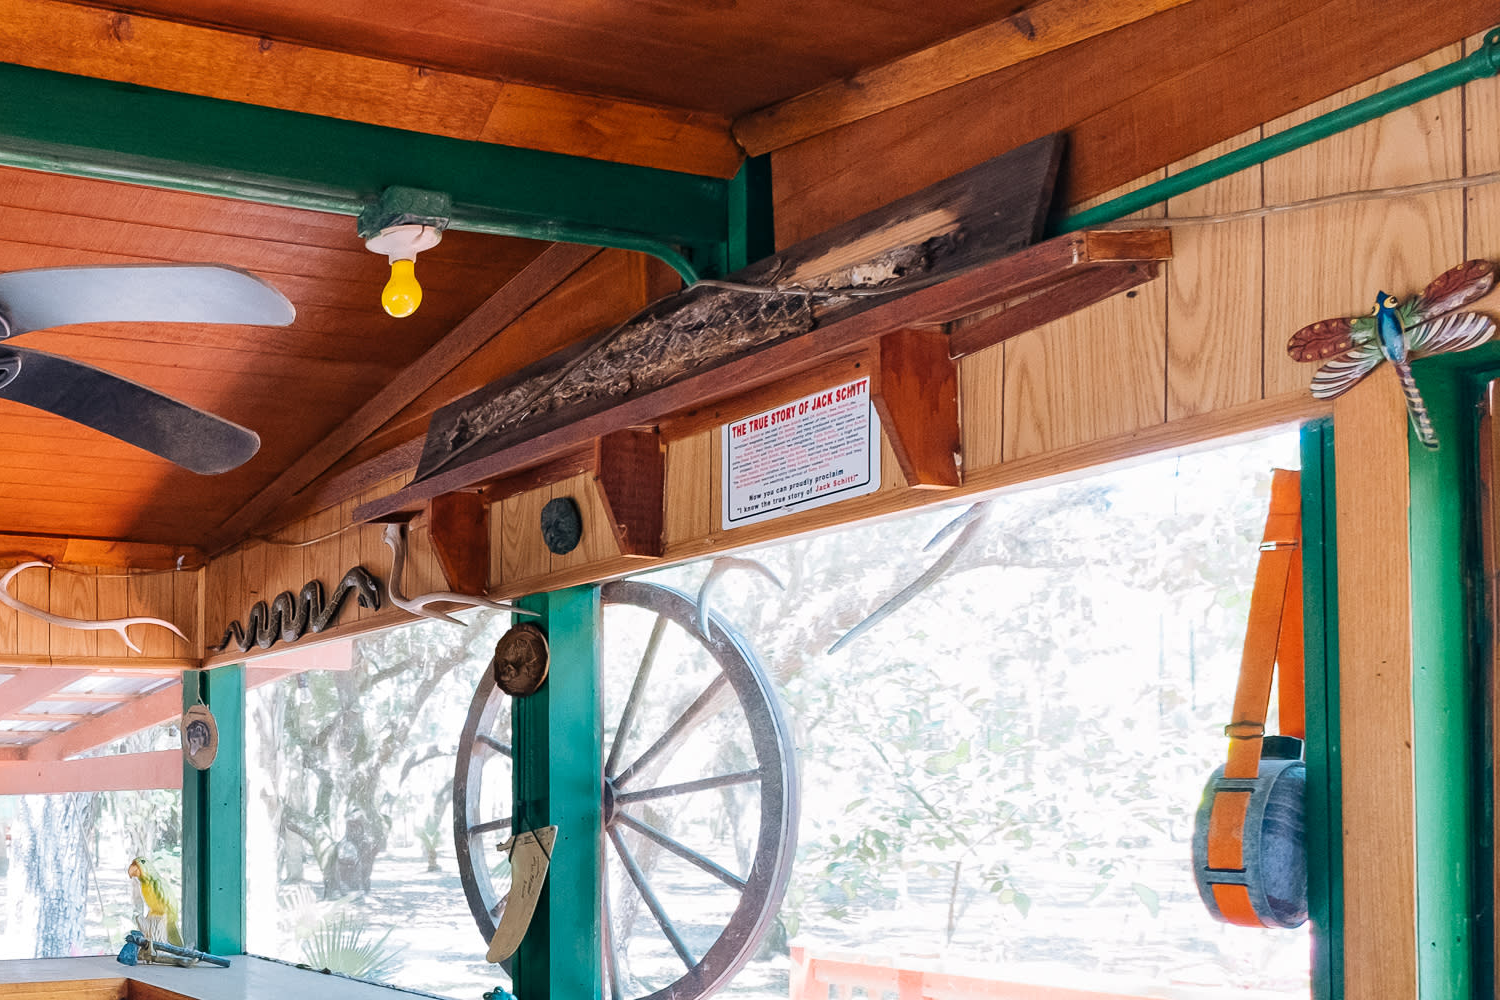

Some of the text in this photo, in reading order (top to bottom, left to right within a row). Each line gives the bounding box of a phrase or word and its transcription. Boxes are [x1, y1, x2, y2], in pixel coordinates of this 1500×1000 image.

[732, 380, 867, 439] THE TRUE STORY OF JACK SCHITT
[744, 504, 759, 513] know
[761, 500, 771, 508] the
[772, 496, 785, 505] true
[787, 491, 804, 501] story
[806, 487, 813, 496] of
[815, 481, 831, 492] Jack
[763, 490, 774, 499] you
[776, 486, 787, 494] can
[789, 478, 813, 491] proudly
[815, 469, 844, 484] proclaim
